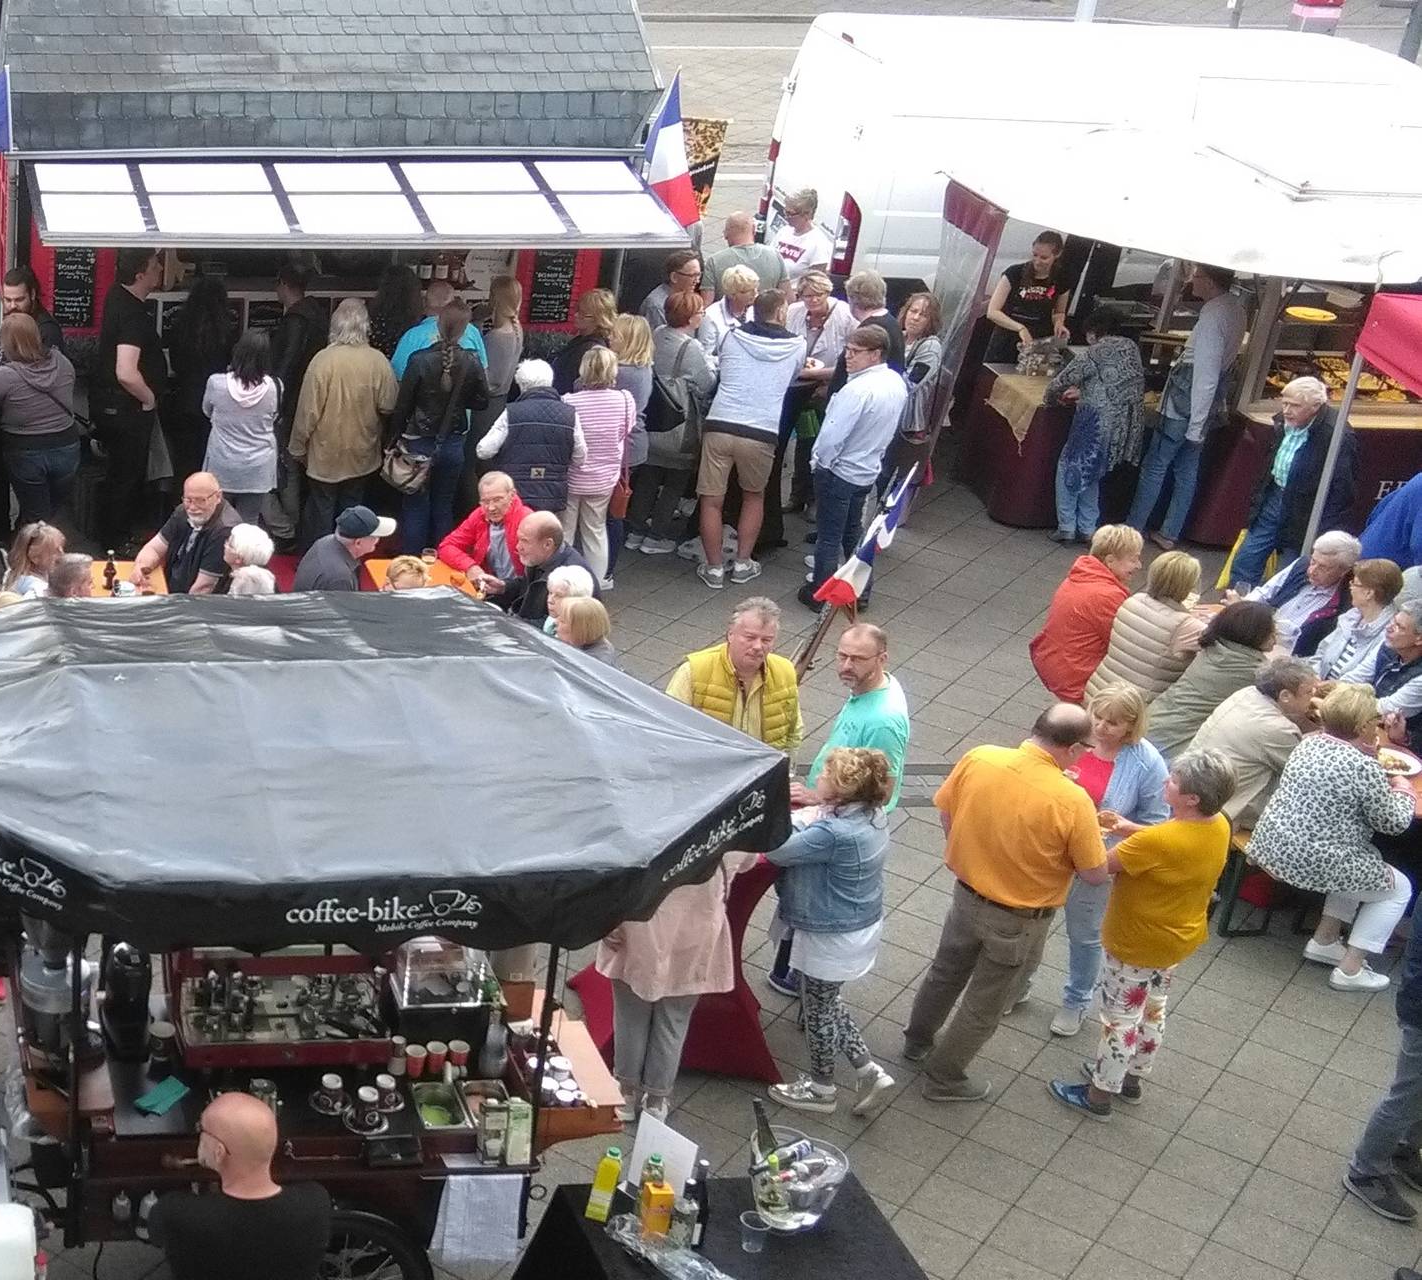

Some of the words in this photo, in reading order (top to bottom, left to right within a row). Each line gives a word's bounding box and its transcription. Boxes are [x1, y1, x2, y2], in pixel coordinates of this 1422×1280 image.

[2, 878, 25, 895] Coffee
[25, 889, 63, 911] Company
[285, 896, 421, 924] coffee-bike
[375, 923, 404, 933] Mobile
[408, 920, 434, 931] Coffee
[435, 919, 478, 930] Company
